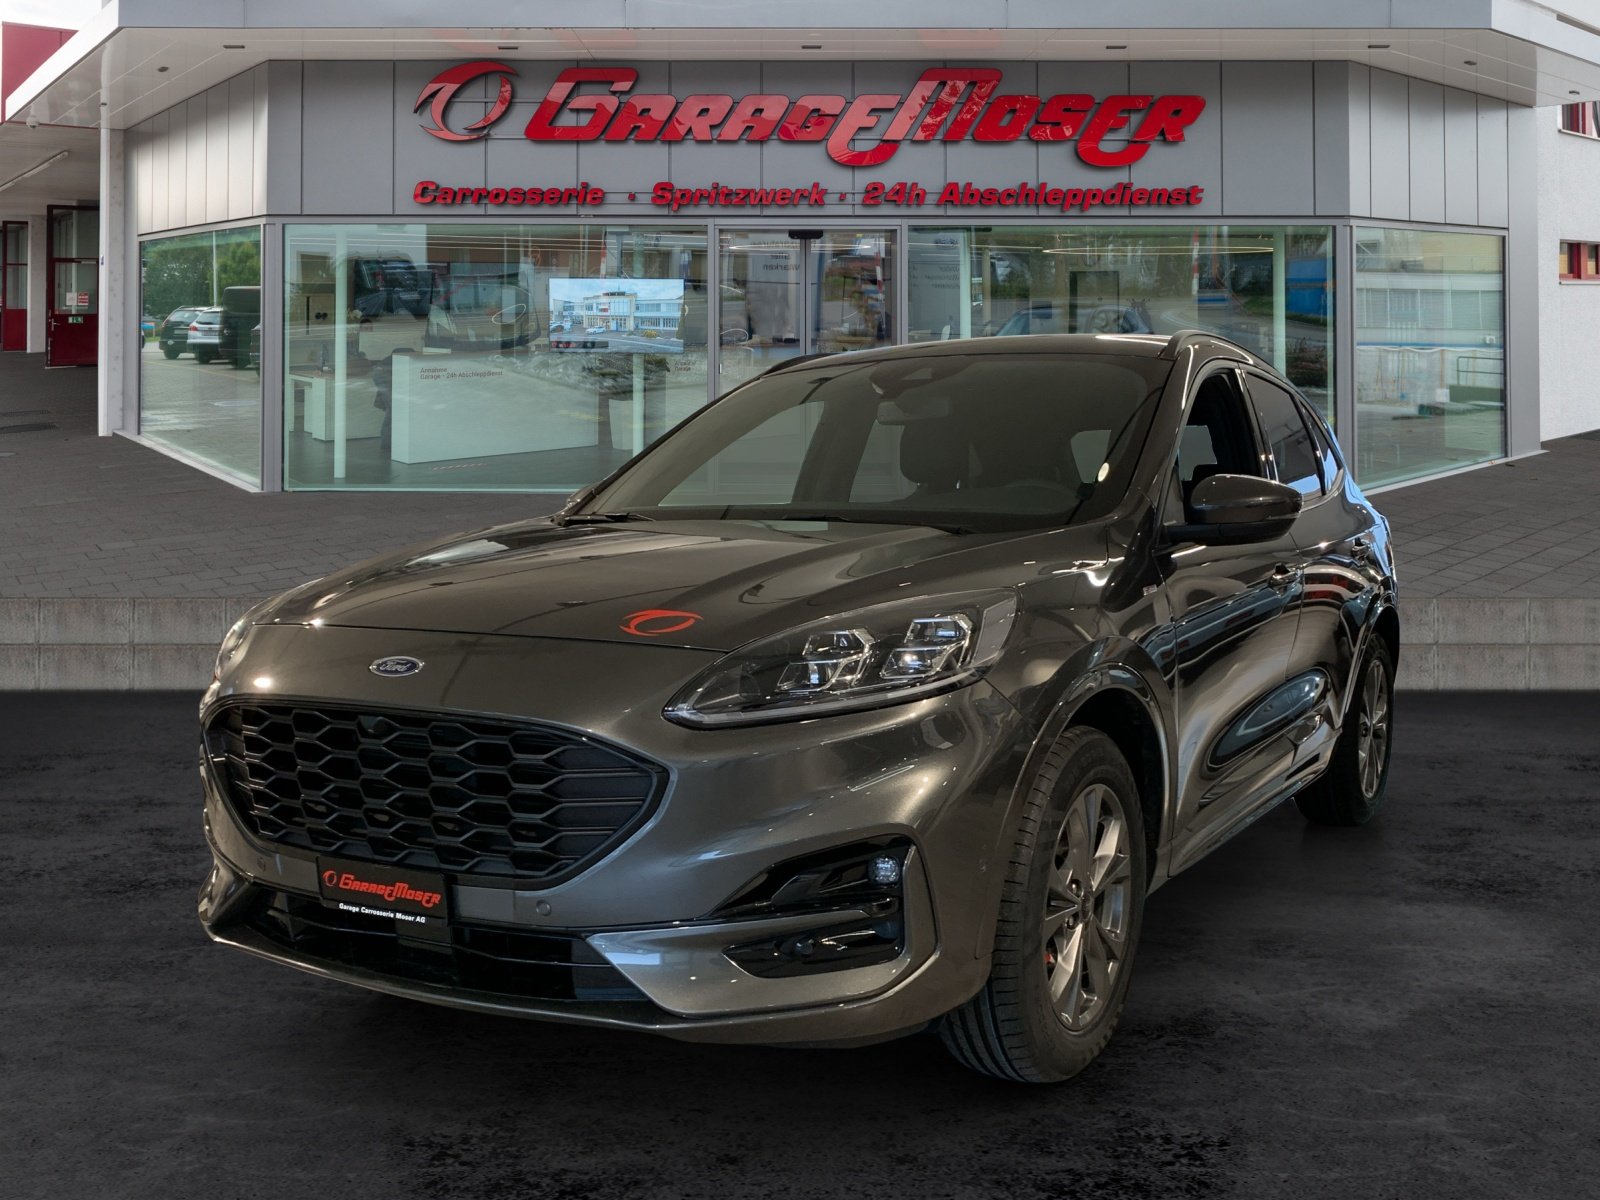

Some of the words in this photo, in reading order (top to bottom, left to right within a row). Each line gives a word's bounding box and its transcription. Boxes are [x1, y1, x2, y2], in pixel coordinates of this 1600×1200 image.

[413, 180, 605, 206] Carrosserie
[650, 181, 826, 212] Spritzwerk
[861, 181, 927, 206] 24h
[936, 181, 1204, 212] Abschleppdienst
[379, 659, 412, 672] Ford
[338, 902, 360, 913] Garage
[360, 906, 394, 919] Carrosserie
[395, 912, 415, 922] Moser
[415, 916, 426, 924] AG
